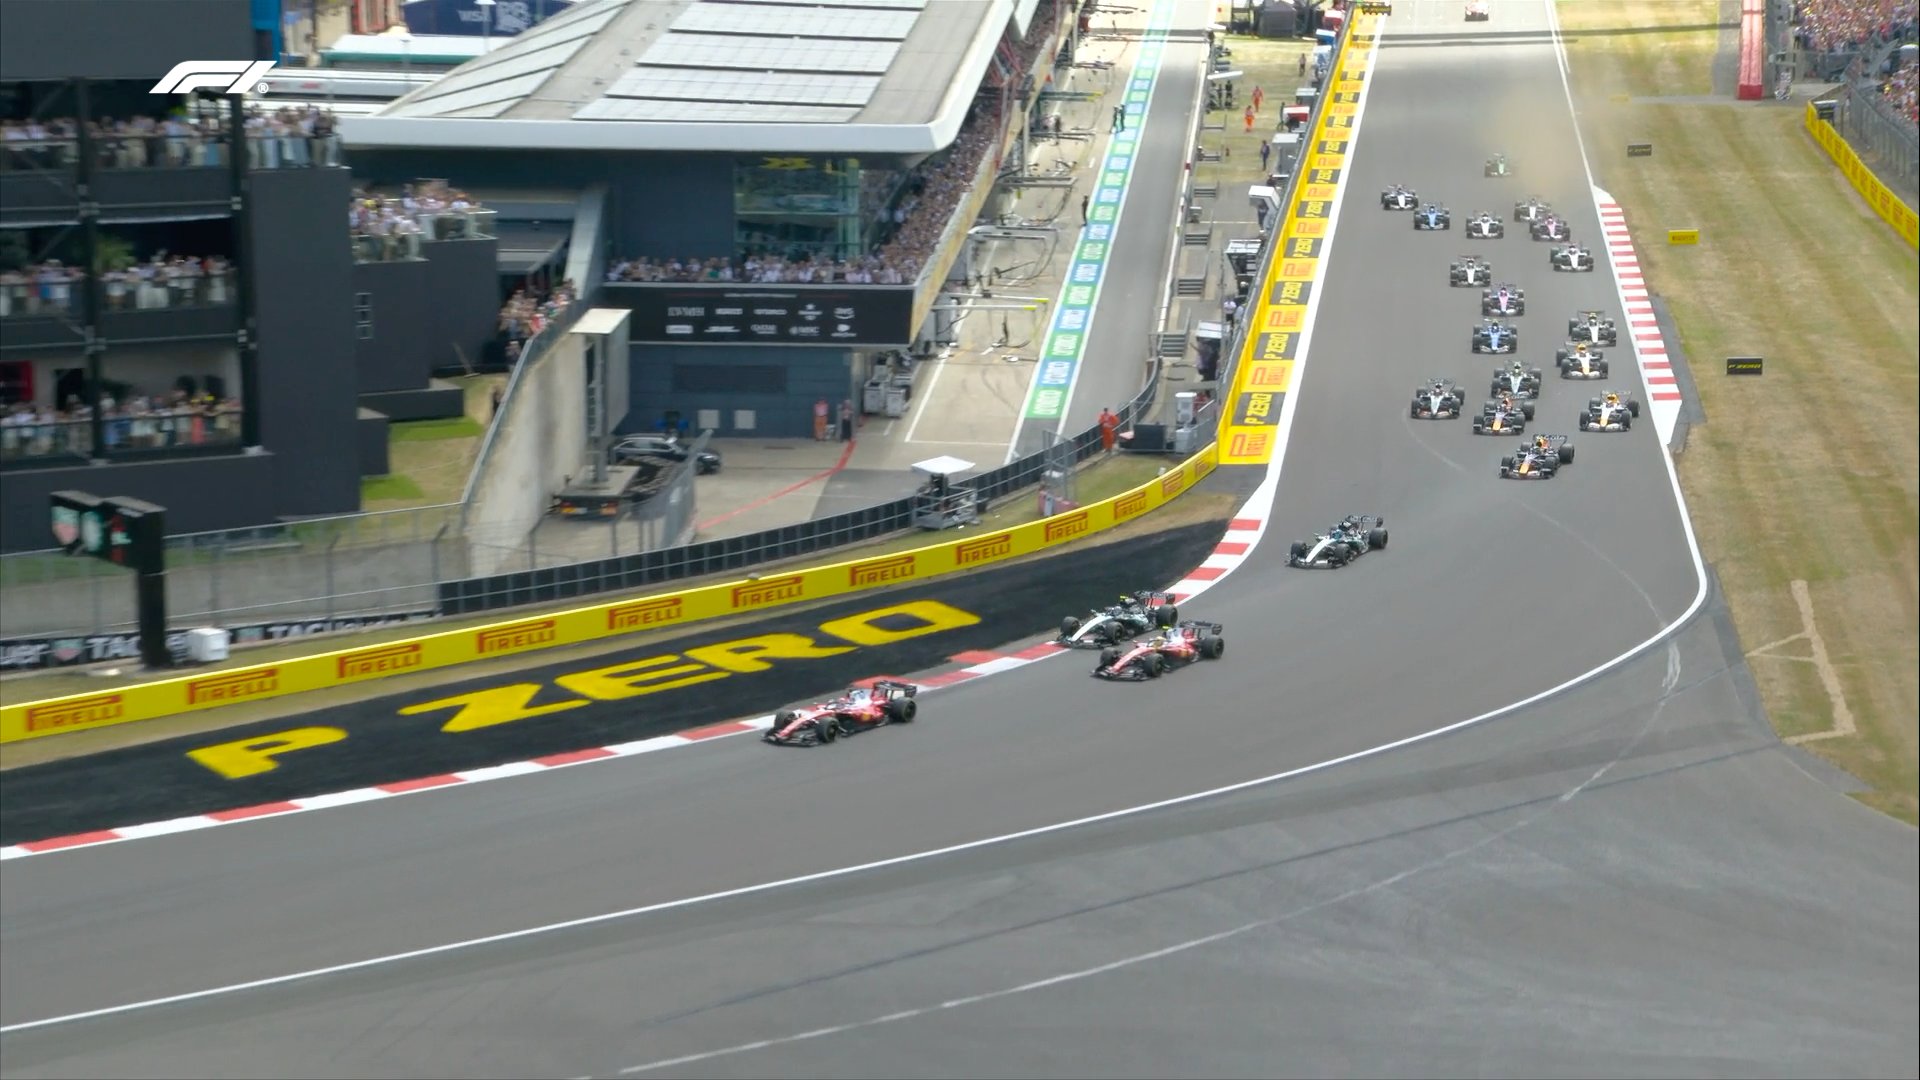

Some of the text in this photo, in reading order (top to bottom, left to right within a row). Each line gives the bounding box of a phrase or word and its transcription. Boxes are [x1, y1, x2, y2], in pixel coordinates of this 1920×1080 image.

[1246, 393, 1272, 416] ZERO
[1114, 491, 1146, 519] PIRELLI
[1045, 512, 1088, 543] PIRELLI
[956, 534, 1011, 565] PIRELLI
[849, 555, 916, 587] PIRELLI
[731, 576, 804, 608] PIRELLI
[608, 597, 682, 630] PIRELLI
[477, 619, 556, 654] PIRELLI
[338, 643, 422, 678] PIRELLI
[185, 600, 982, 779] P ZERO
[188, 669, 279, 705] PIRELLI
[27, 694, 123, 732] PIRELLI
